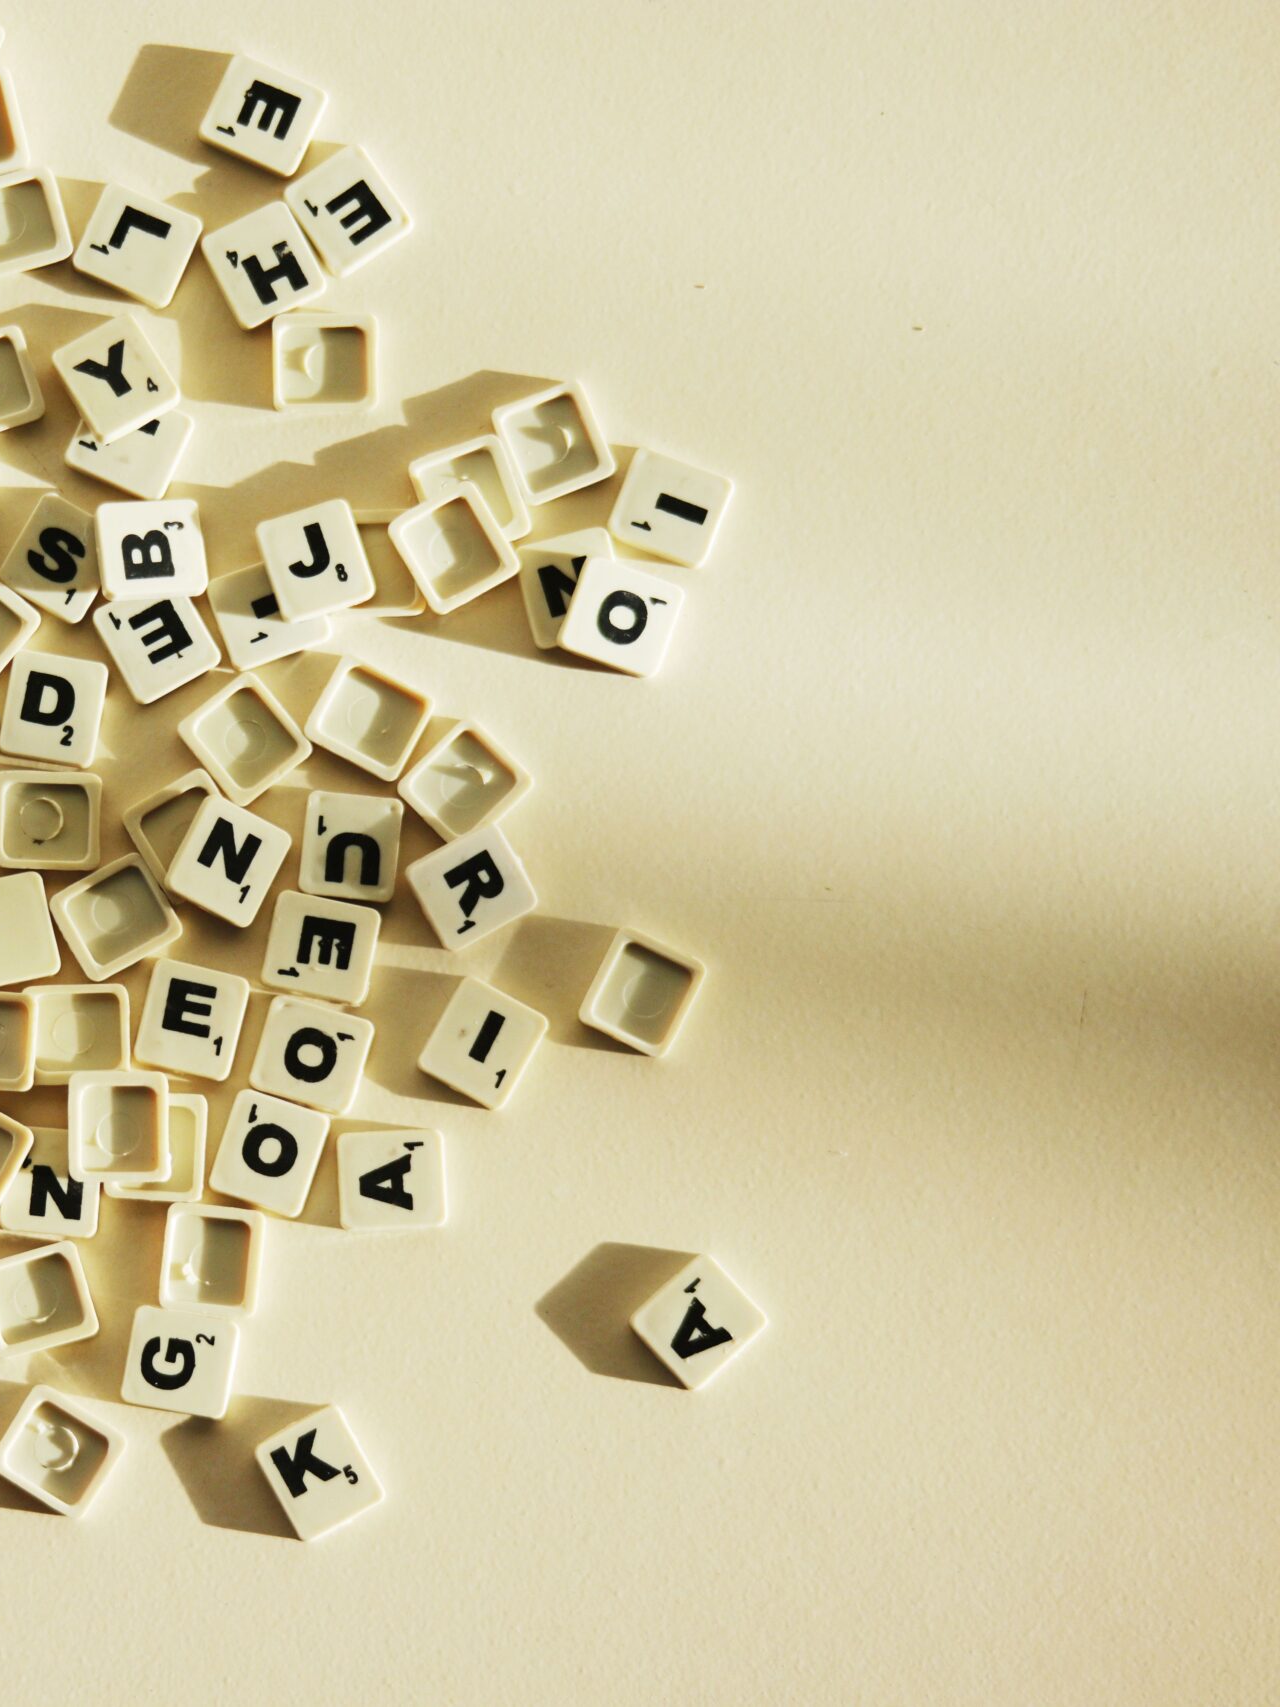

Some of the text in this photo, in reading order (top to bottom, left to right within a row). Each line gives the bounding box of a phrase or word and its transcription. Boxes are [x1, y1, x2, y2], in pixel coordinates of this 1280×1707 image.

[217, 80, 301, 139] E 1
[90, 206, 171, 254] L 1
[304, 180, 391, 245] E 1
[241, 241, 308, 304] H
[73, 340, 158, 397] Y 4
[631, 493, 708, 531] I 1
[27, 527, 85, 604] S 1
[122, 530, 175, 579] B
[289, 523, 348, 581] J 8
[109, 600, 193, 664] E 1
[251, 632, 268, 643] 1
[598, 590, 647, 644] O
[20, 671, 75, 746] D 2
[197, 817, 262, 903] N 1
[318, 816, 381, 886] U 1
[444, 850, 504, 934] R 1
[278, 916, 356, 977] E 1
[162, 978, 222, 1056] E 1
[284, 1027, 354, 1083] O 1
[469, 1011, 506, 1088] I 1
[242, 1104, 298, 1177] O 1
[29, 1165, 83, 1220] N
[359, 1142, 423, 1210] A 1
[671, 1278, 733, 1359] A 1
[141, 1334, 215, 1390] G 2
[270, 1429, 358, 1498] K 5
